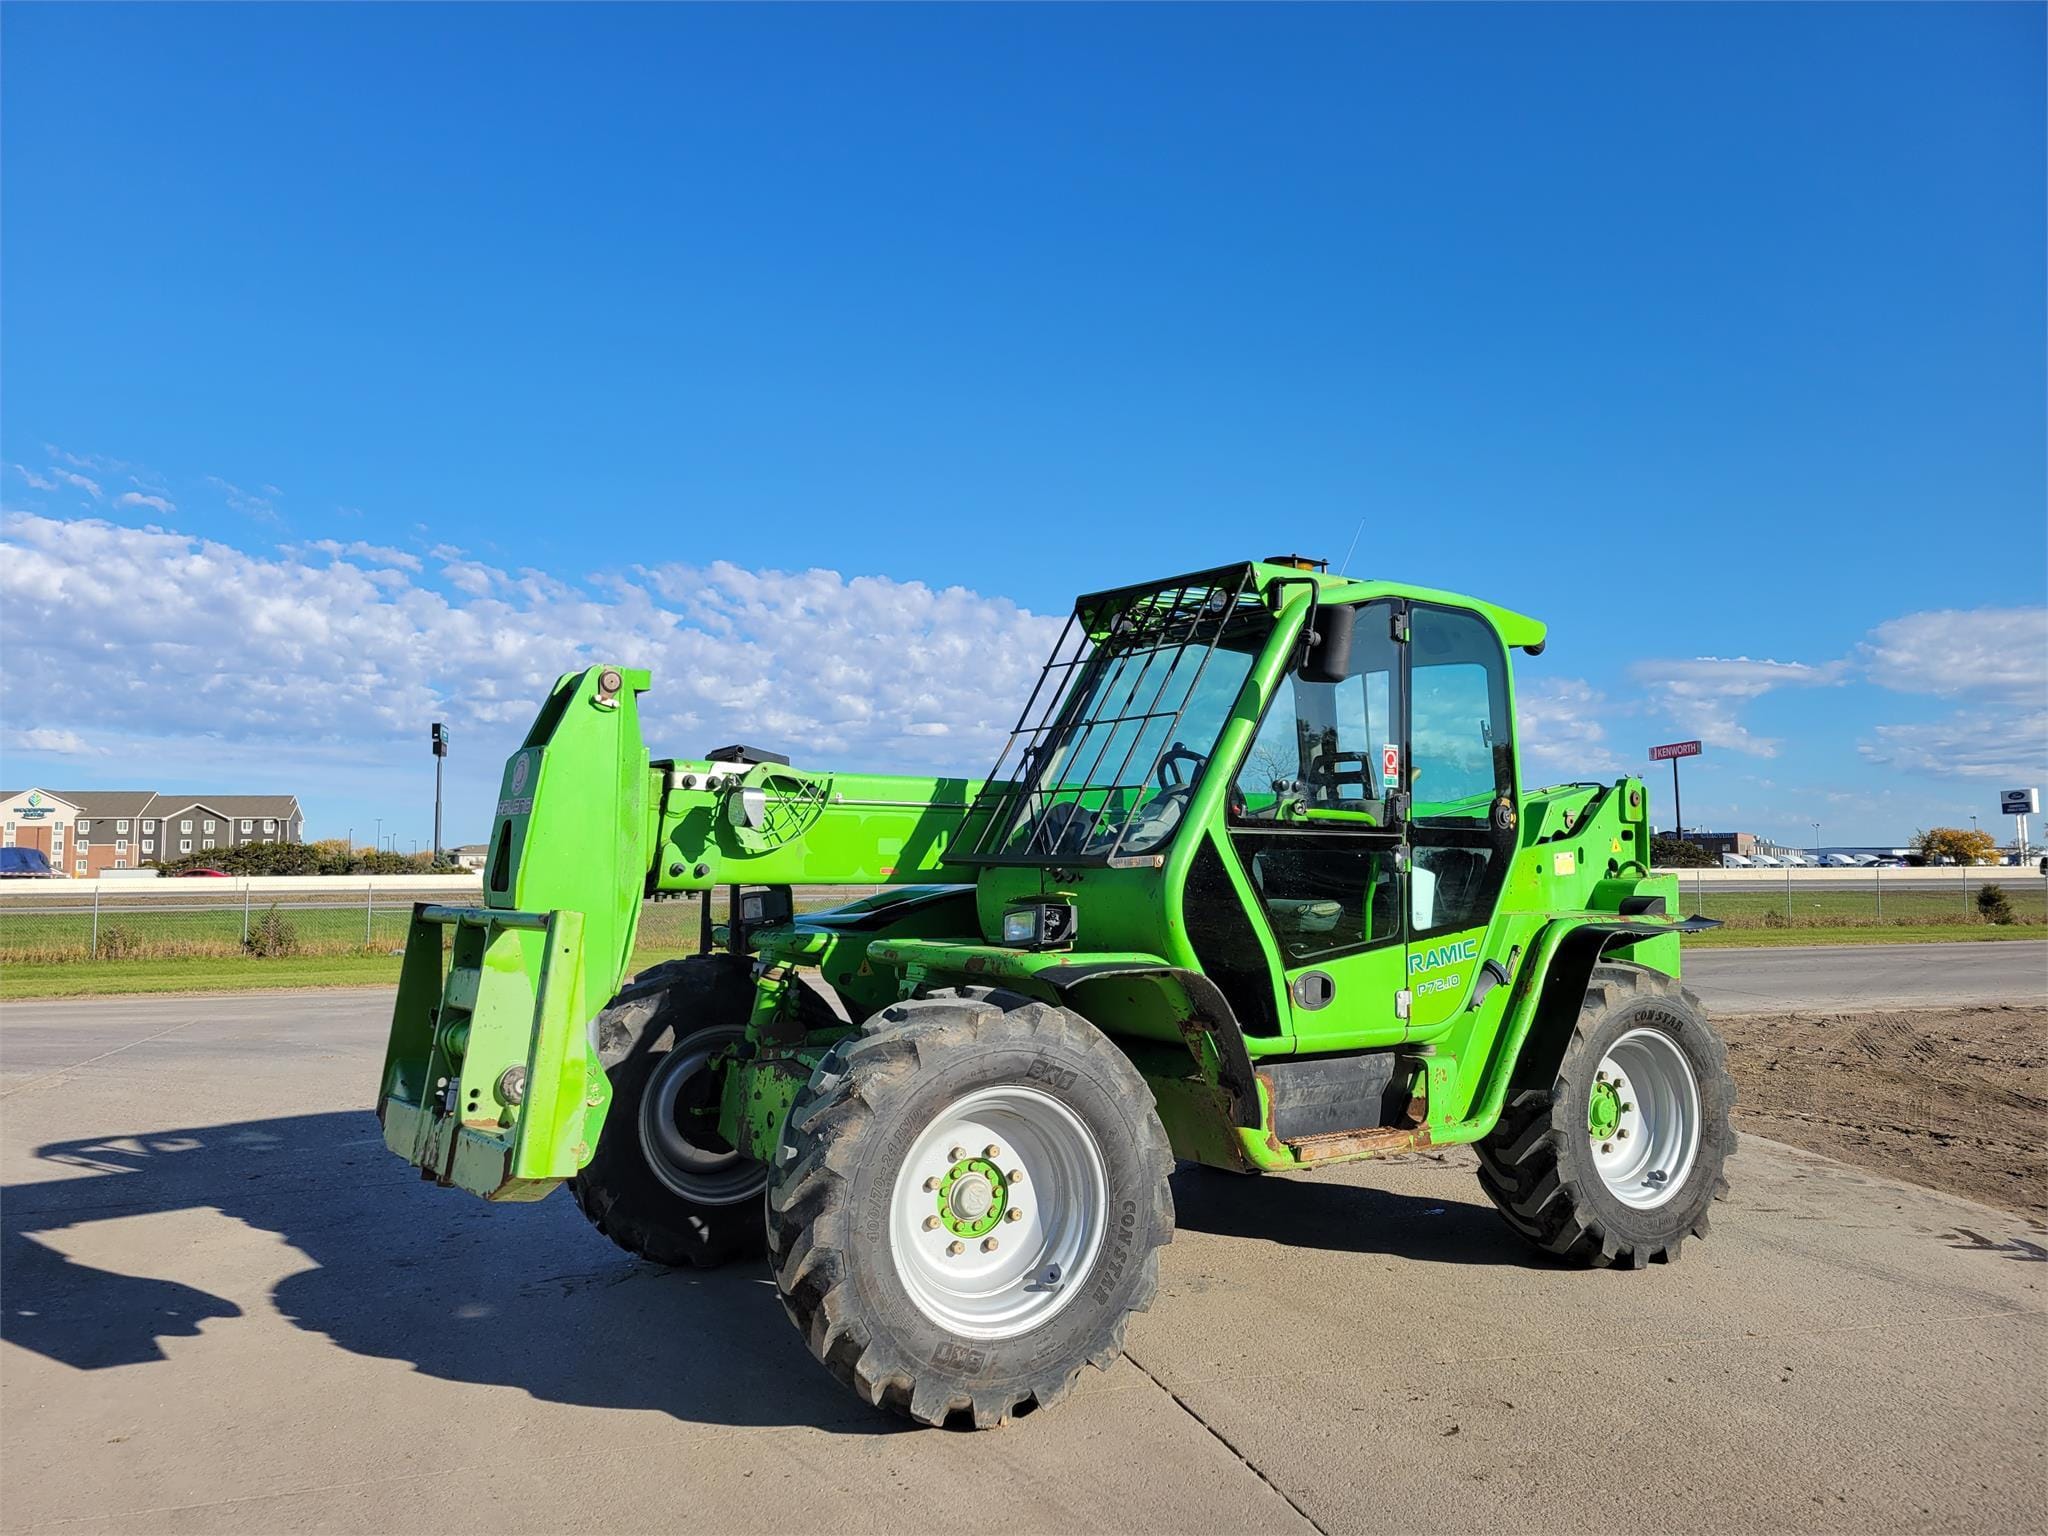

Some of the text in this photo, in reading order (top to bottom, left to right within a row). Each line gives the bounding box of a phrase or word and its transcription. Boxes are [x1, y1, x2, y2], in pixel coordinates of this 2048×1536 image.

[1657, 743, 1697, 758] KENWORTH
[1408, 939, 1477, 974] RAMIC
[1417, 974, 1460, 996] P72.10
